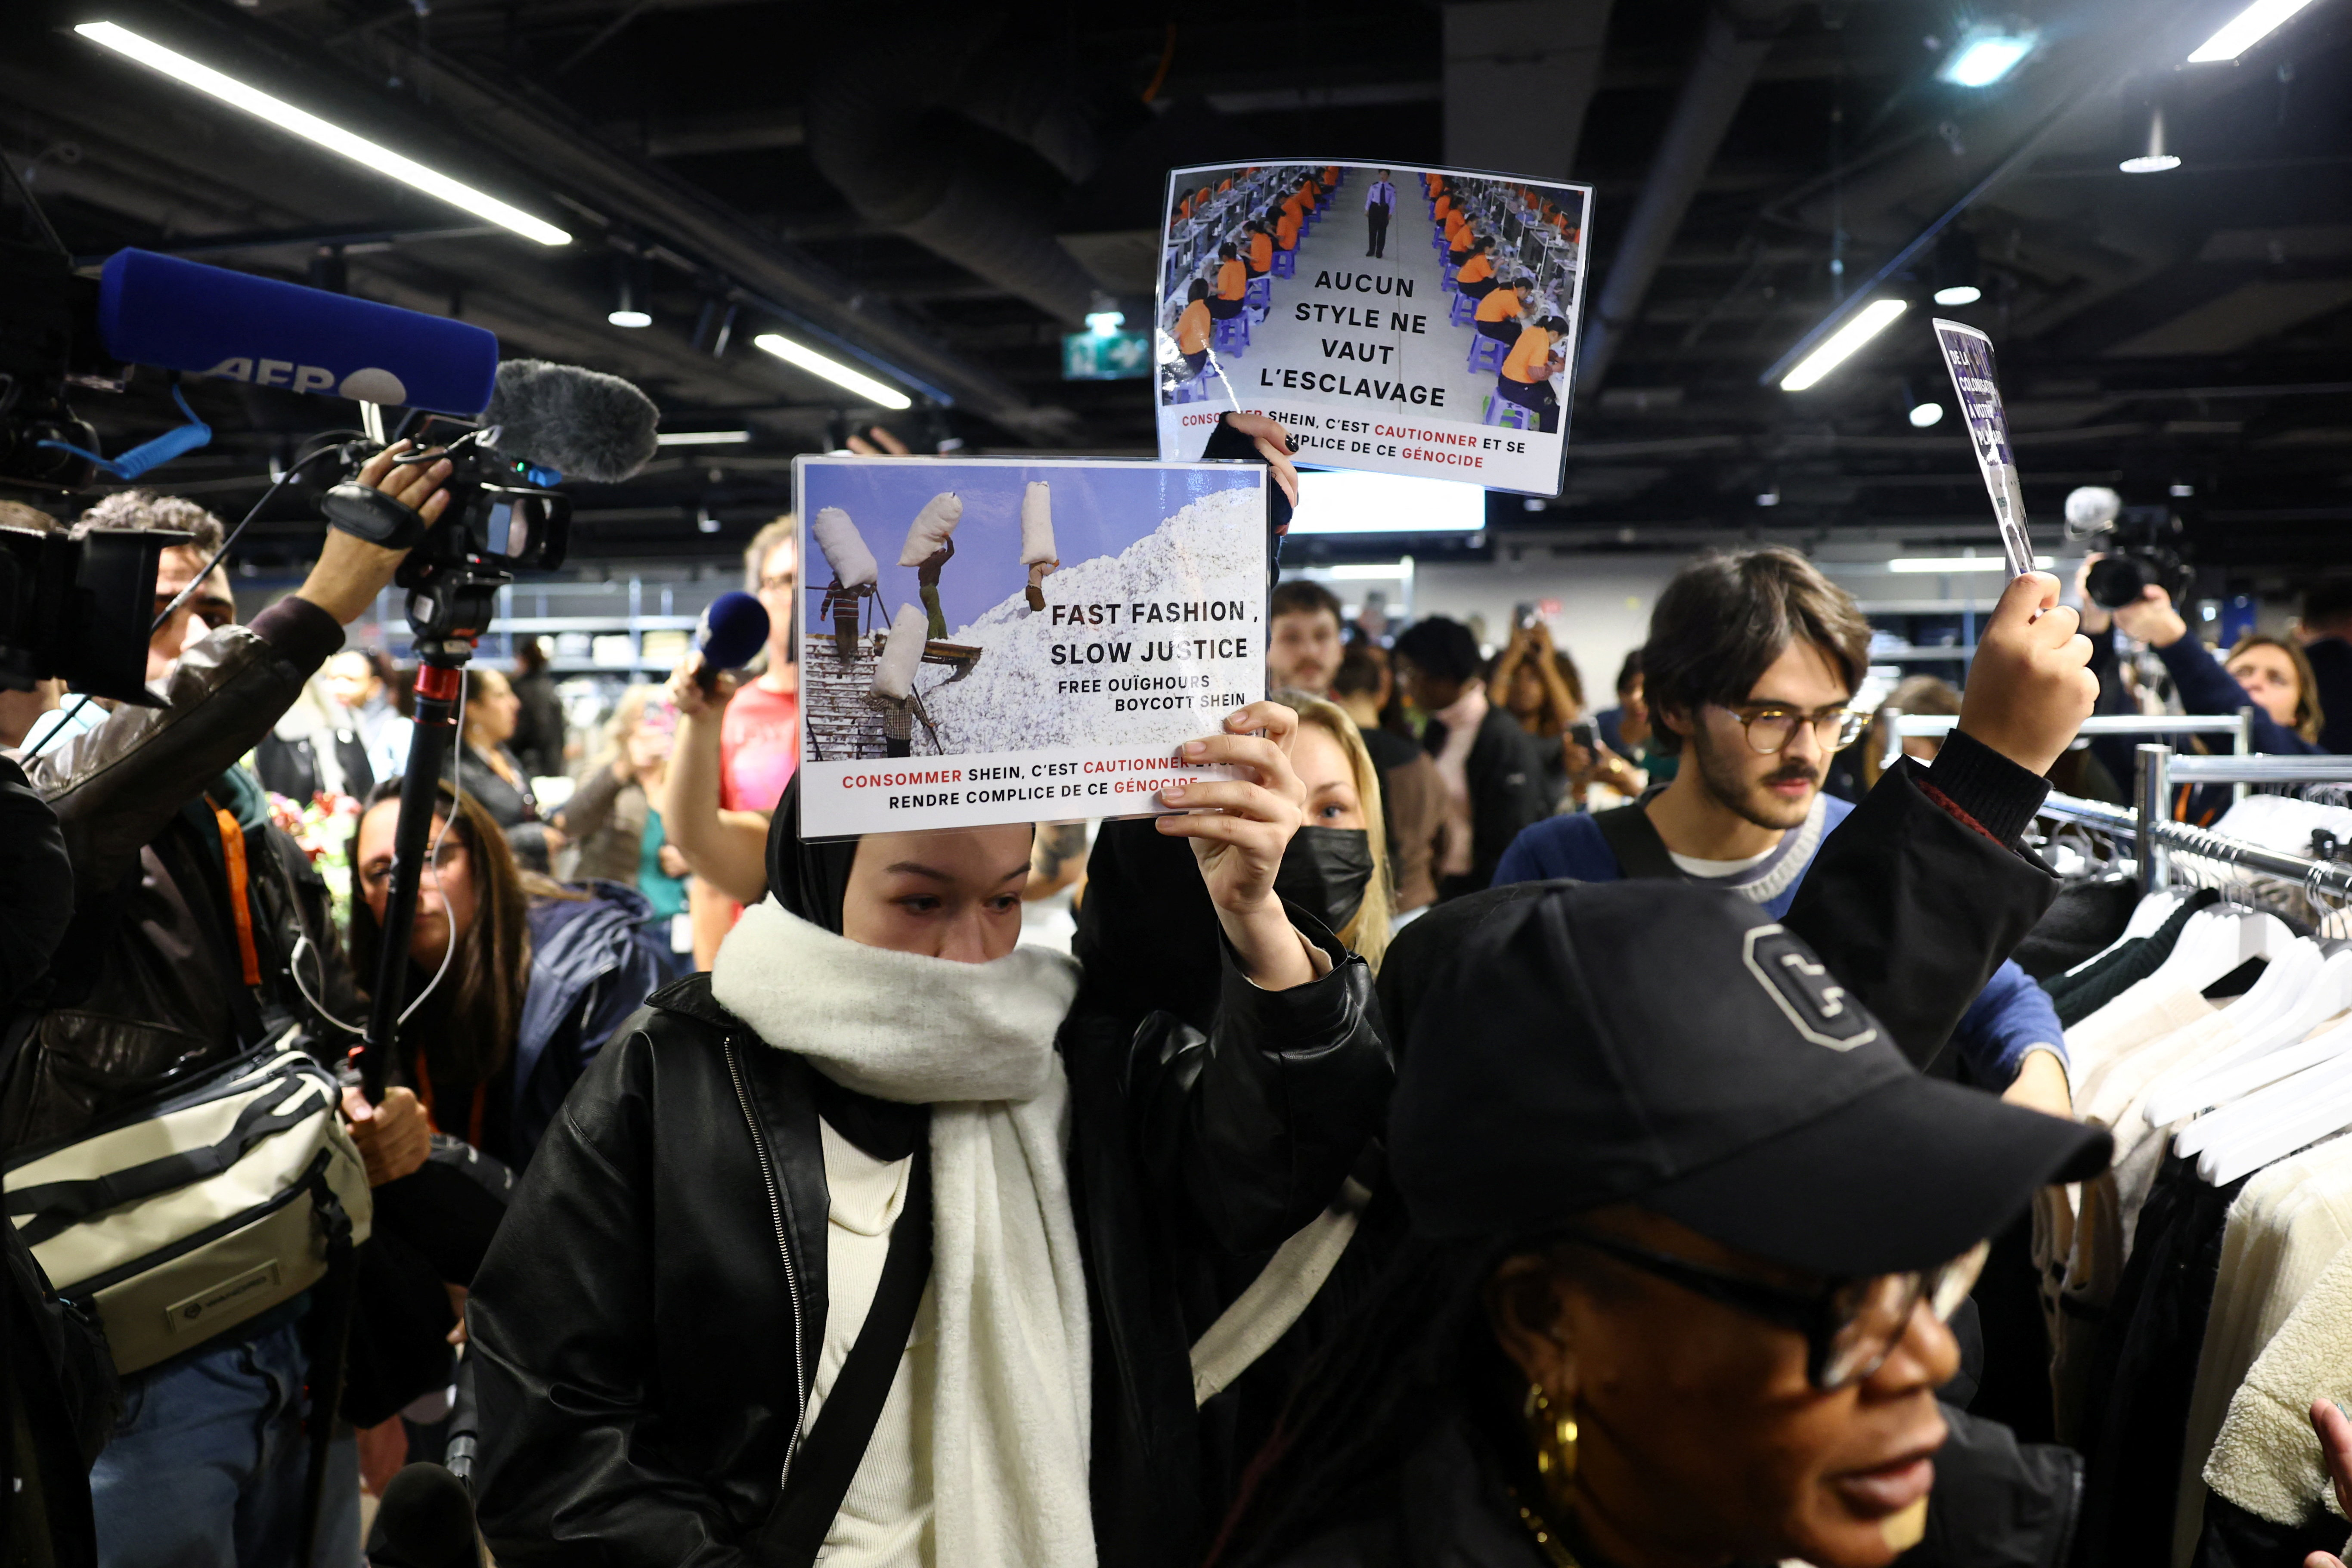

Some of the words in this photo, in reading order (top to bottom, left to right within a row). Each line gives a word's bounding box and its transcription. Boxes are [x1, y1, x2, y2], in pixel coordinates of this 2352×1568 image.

[1314, 270, 1414, 297] AUCUN
[1295, 303, 1379, 328] STYLE
[1391, 312, 1426, 334] NE
[1322, 339, 1394, 365] VAUT
[202, 357, 335, 394] AFP
[1261, 368, 1445, 407] L'ESCLAVAGE
[1268, 411, 1320, 429] SHEIN,
[1326, 418, 1370, 434] C'EST
[1375, 425, 1477, 448] CAUTIONNER
[1483, 439, 1502, 450] ET
[1506, 440, 1525, 454] SE
[1976, 430, 2005, 445] PLAARD
[1290, 433, 1345, 451] PLICE
[1351, 441, 1371, 454] DE
[1377, 444, 1397, 457] CE
[1402, 448, 1484, 468] GÉNOCIDE
[1052, 604, 1121, 626] FAST
[1132, 601, 1244, 623] FASHION
[1051, 642, 1132, 665] SLOW
[1140, 638, 1247, 662] JUSTICE
[1059, 679, 1101, 694] FREE
[1108, 675, 1210, 691] OUÏGHOURS
[1115, 696, 1194, 712] BOYCOTT
[1200, 693, 1245, 707] SHEIN
[843, 770, 961, 789] CONSOMMER
[969, 766, 1025, 782] SHEIN,
[1032, 762, 1078, 777] C'EST
[889, 793, 959, 809] RENDRE
[967, 787, 1054, 803] COMPLICE
[1062, 784, 1081, 797] DE
[1088, 782, 1108, 795] CE
